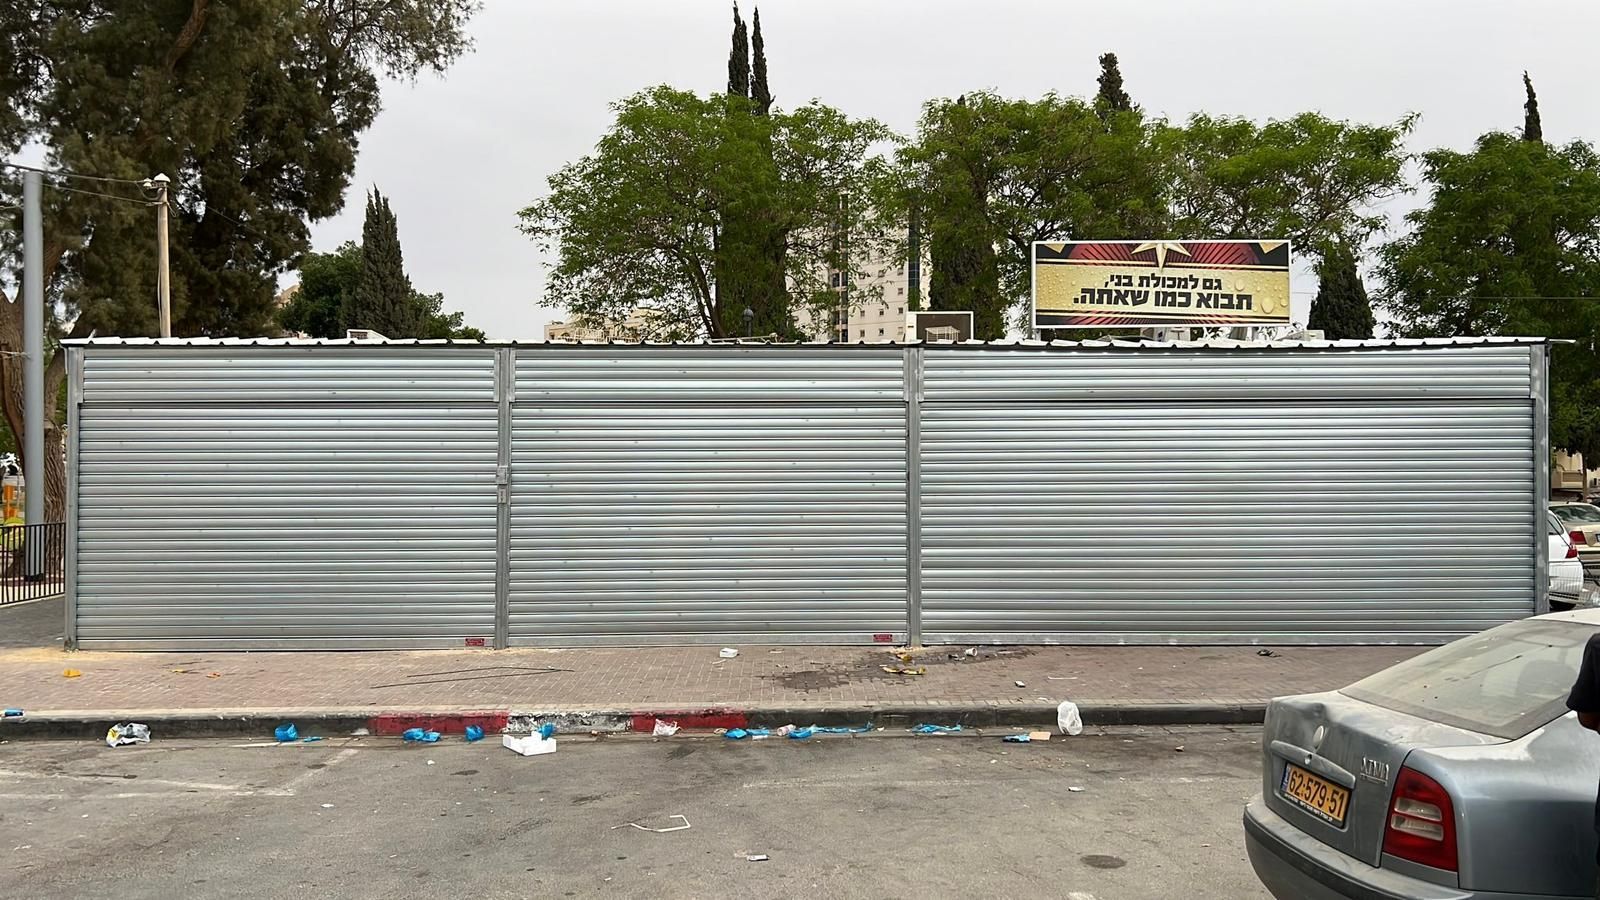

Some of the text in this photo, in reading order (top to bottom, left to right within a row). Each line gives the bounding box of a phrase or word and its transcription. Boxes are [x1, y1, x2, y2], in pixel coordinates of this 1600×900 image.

[1104, 273, 1222, 290] גם למכולת בני,
[1073, 288, 1252, 310] תבוא כמו שאתה.
